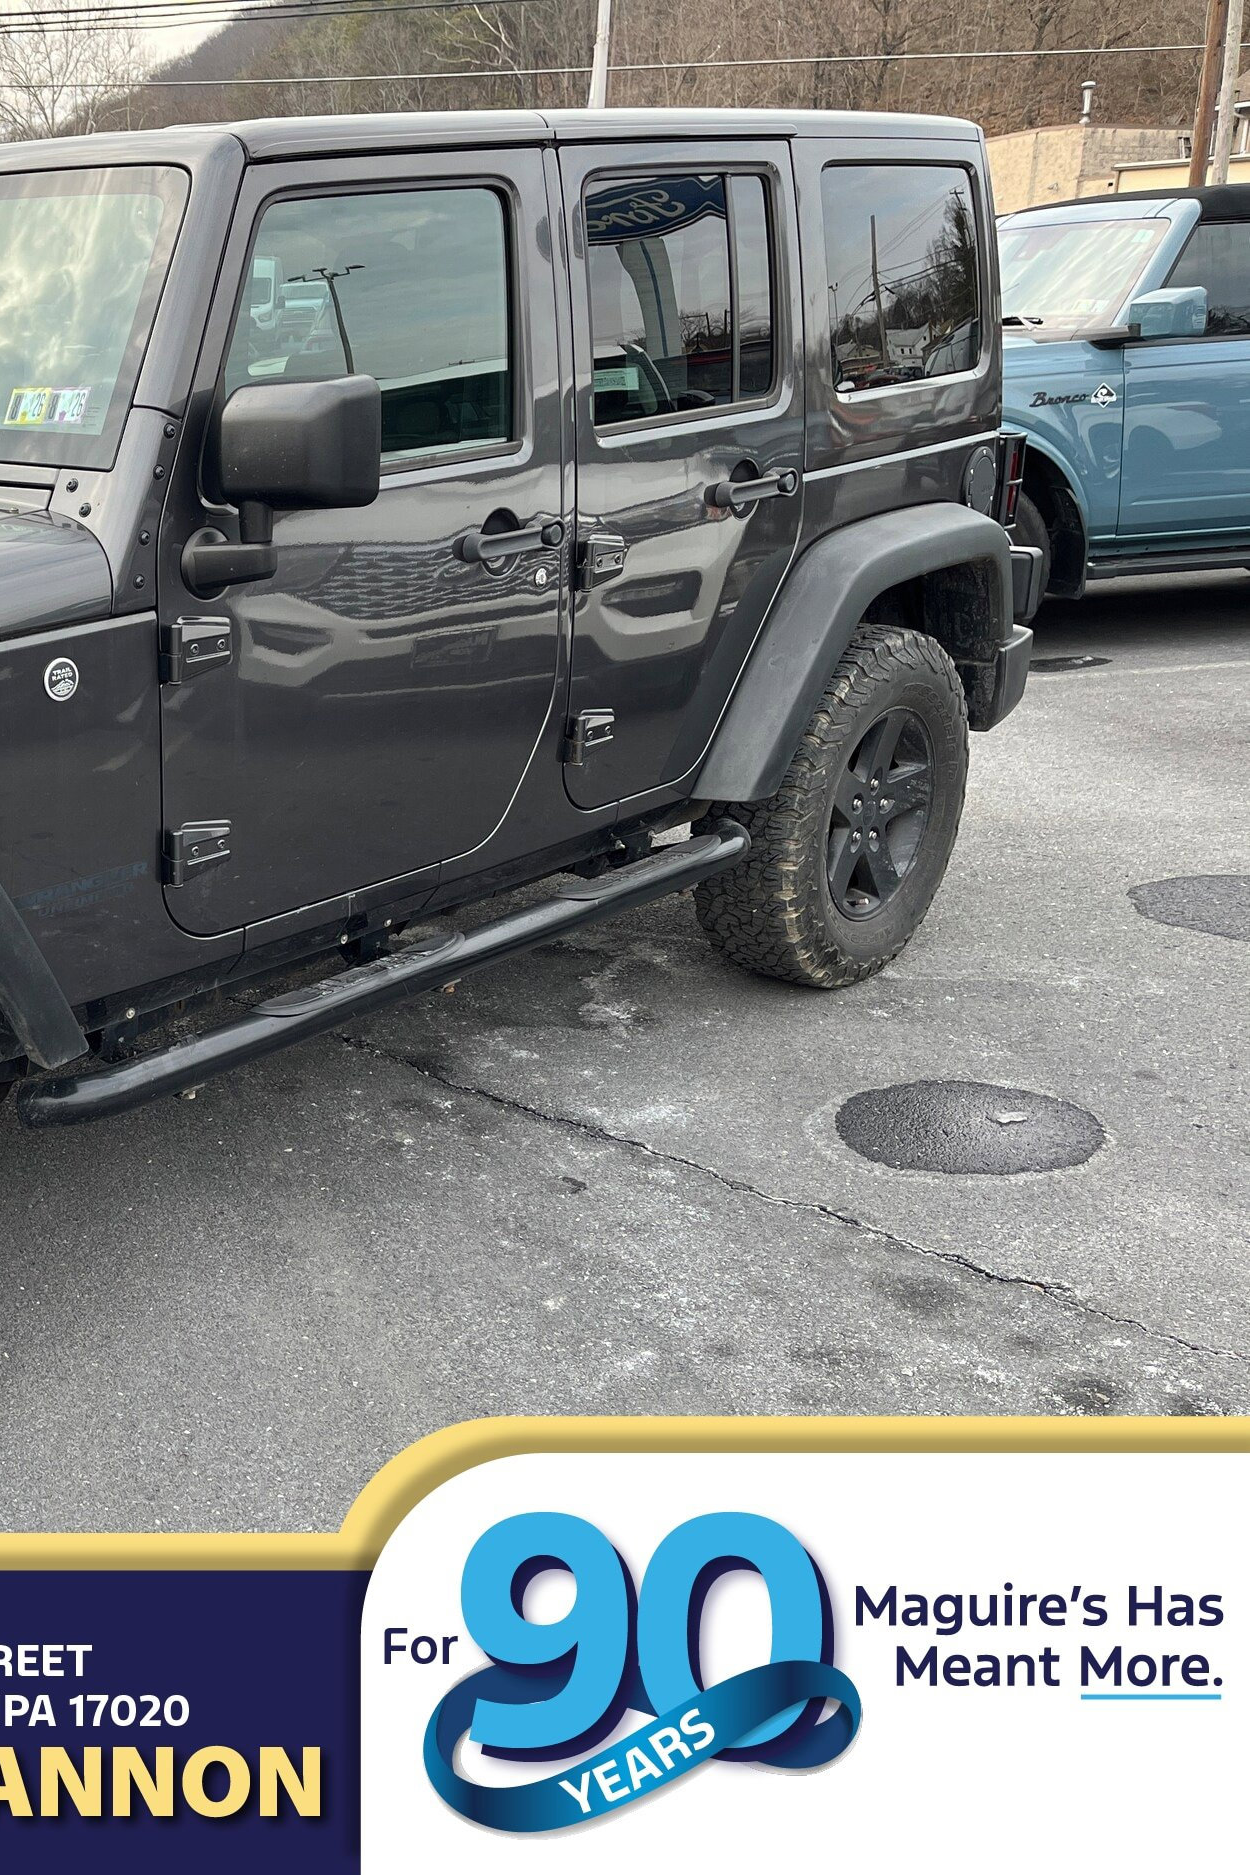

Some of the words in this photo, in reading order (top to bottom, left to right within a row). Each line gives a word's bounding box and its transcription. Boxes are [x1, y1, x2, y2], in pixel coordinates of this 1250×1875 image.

[1029, 391, 1089, 408] Bronco
[52, 667, 72, 676] TRAIL
[51, 672, 73, 681] RATED
